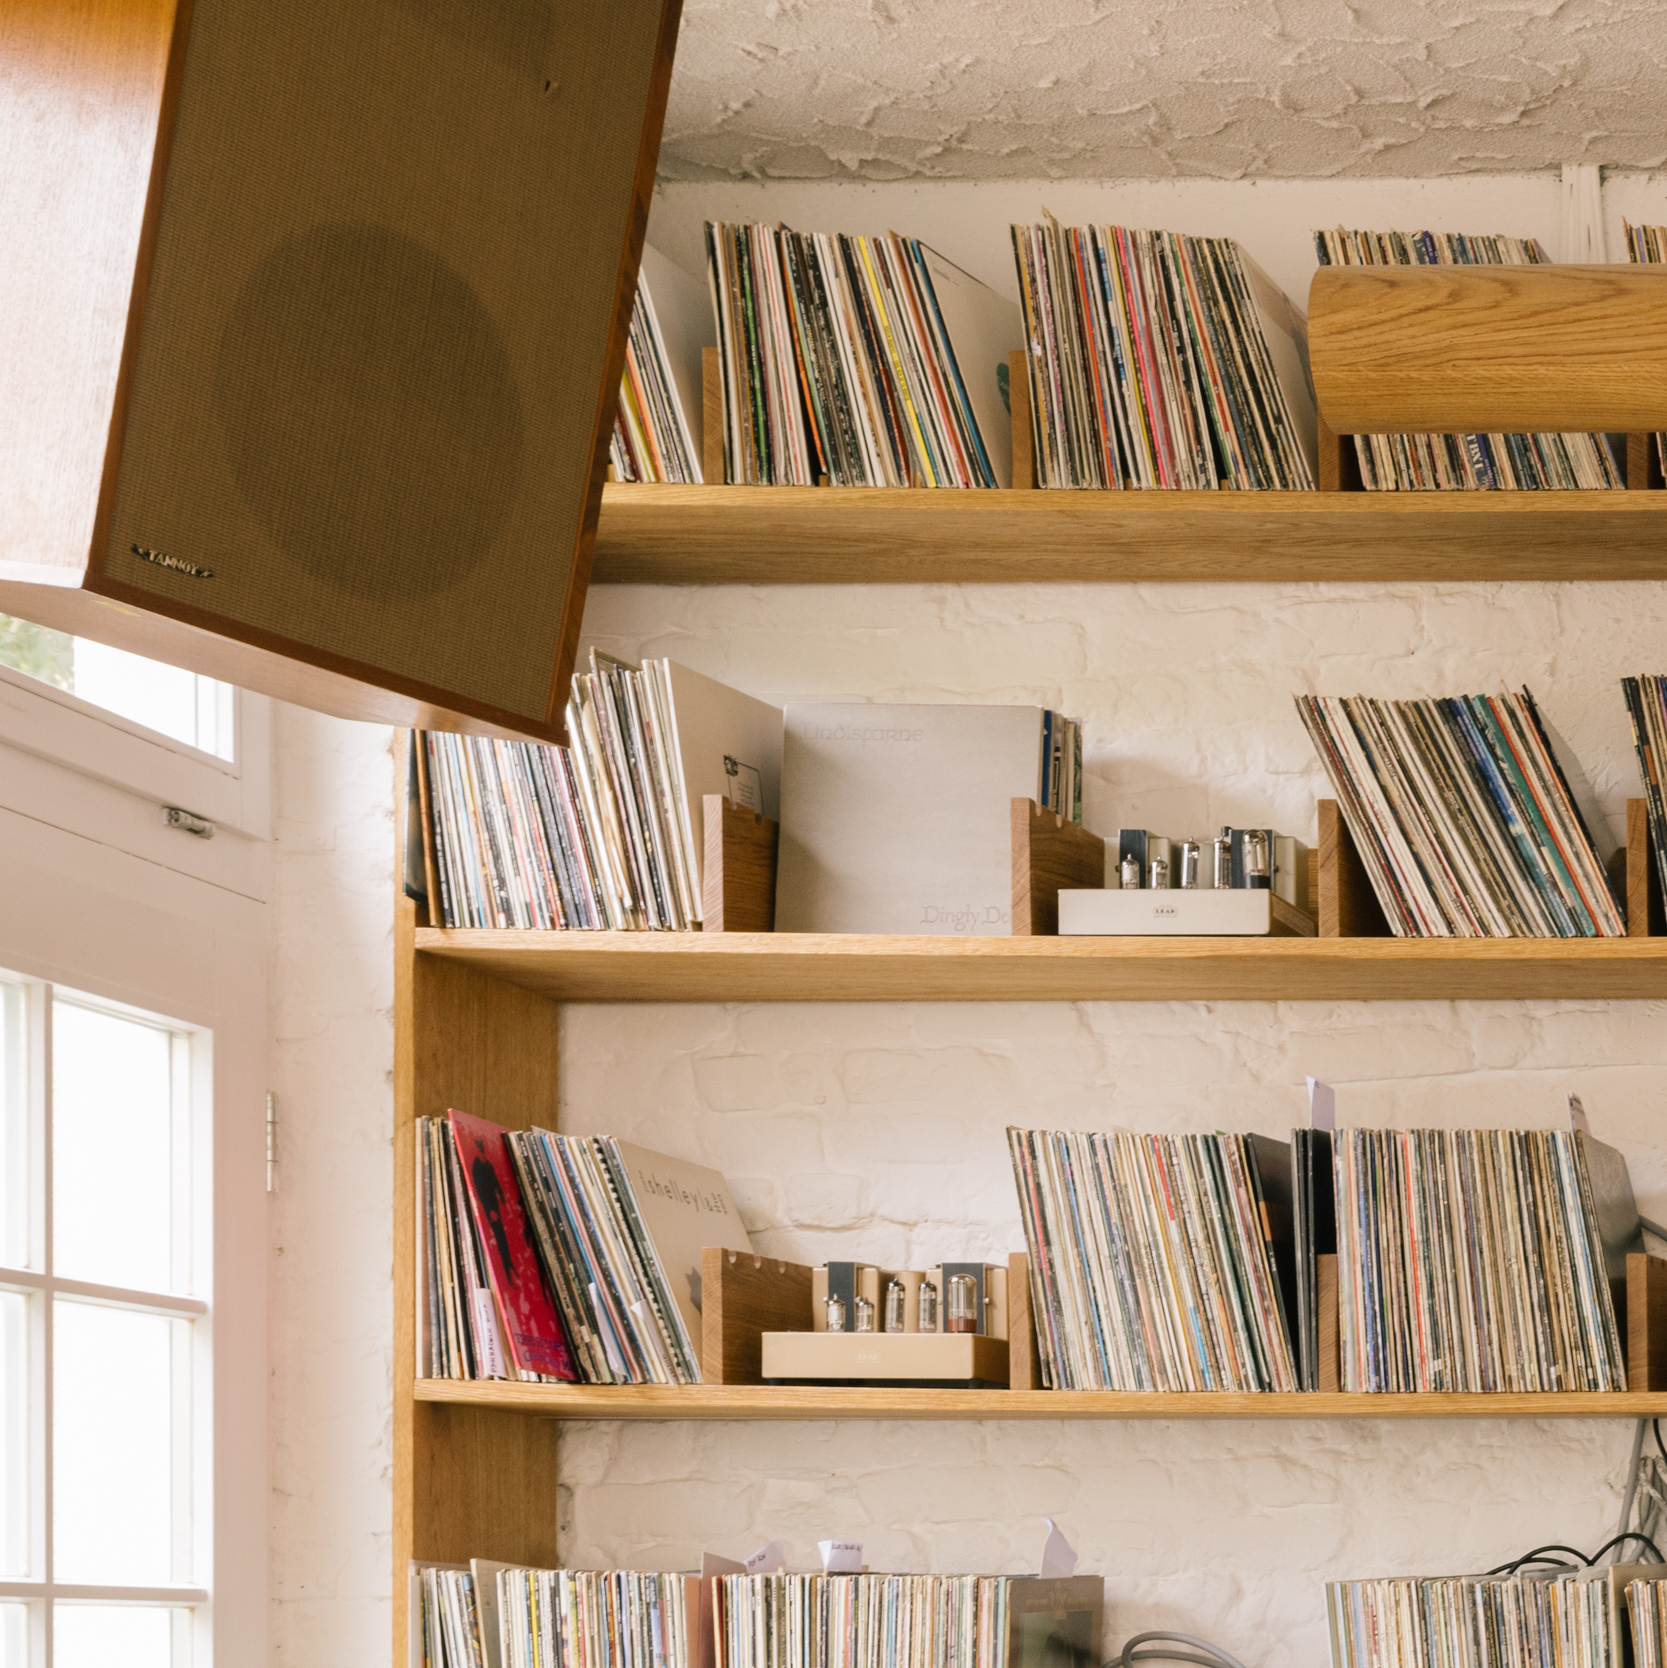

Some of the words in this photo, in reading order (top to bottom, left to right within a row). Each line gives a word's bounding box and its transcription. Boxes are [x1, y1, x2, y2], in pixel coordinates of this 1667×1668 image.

[148, 549, 199, 575] TANNOY
[920, 904, 980, 932] Dingly
[981, 905, 1010, 925] De
